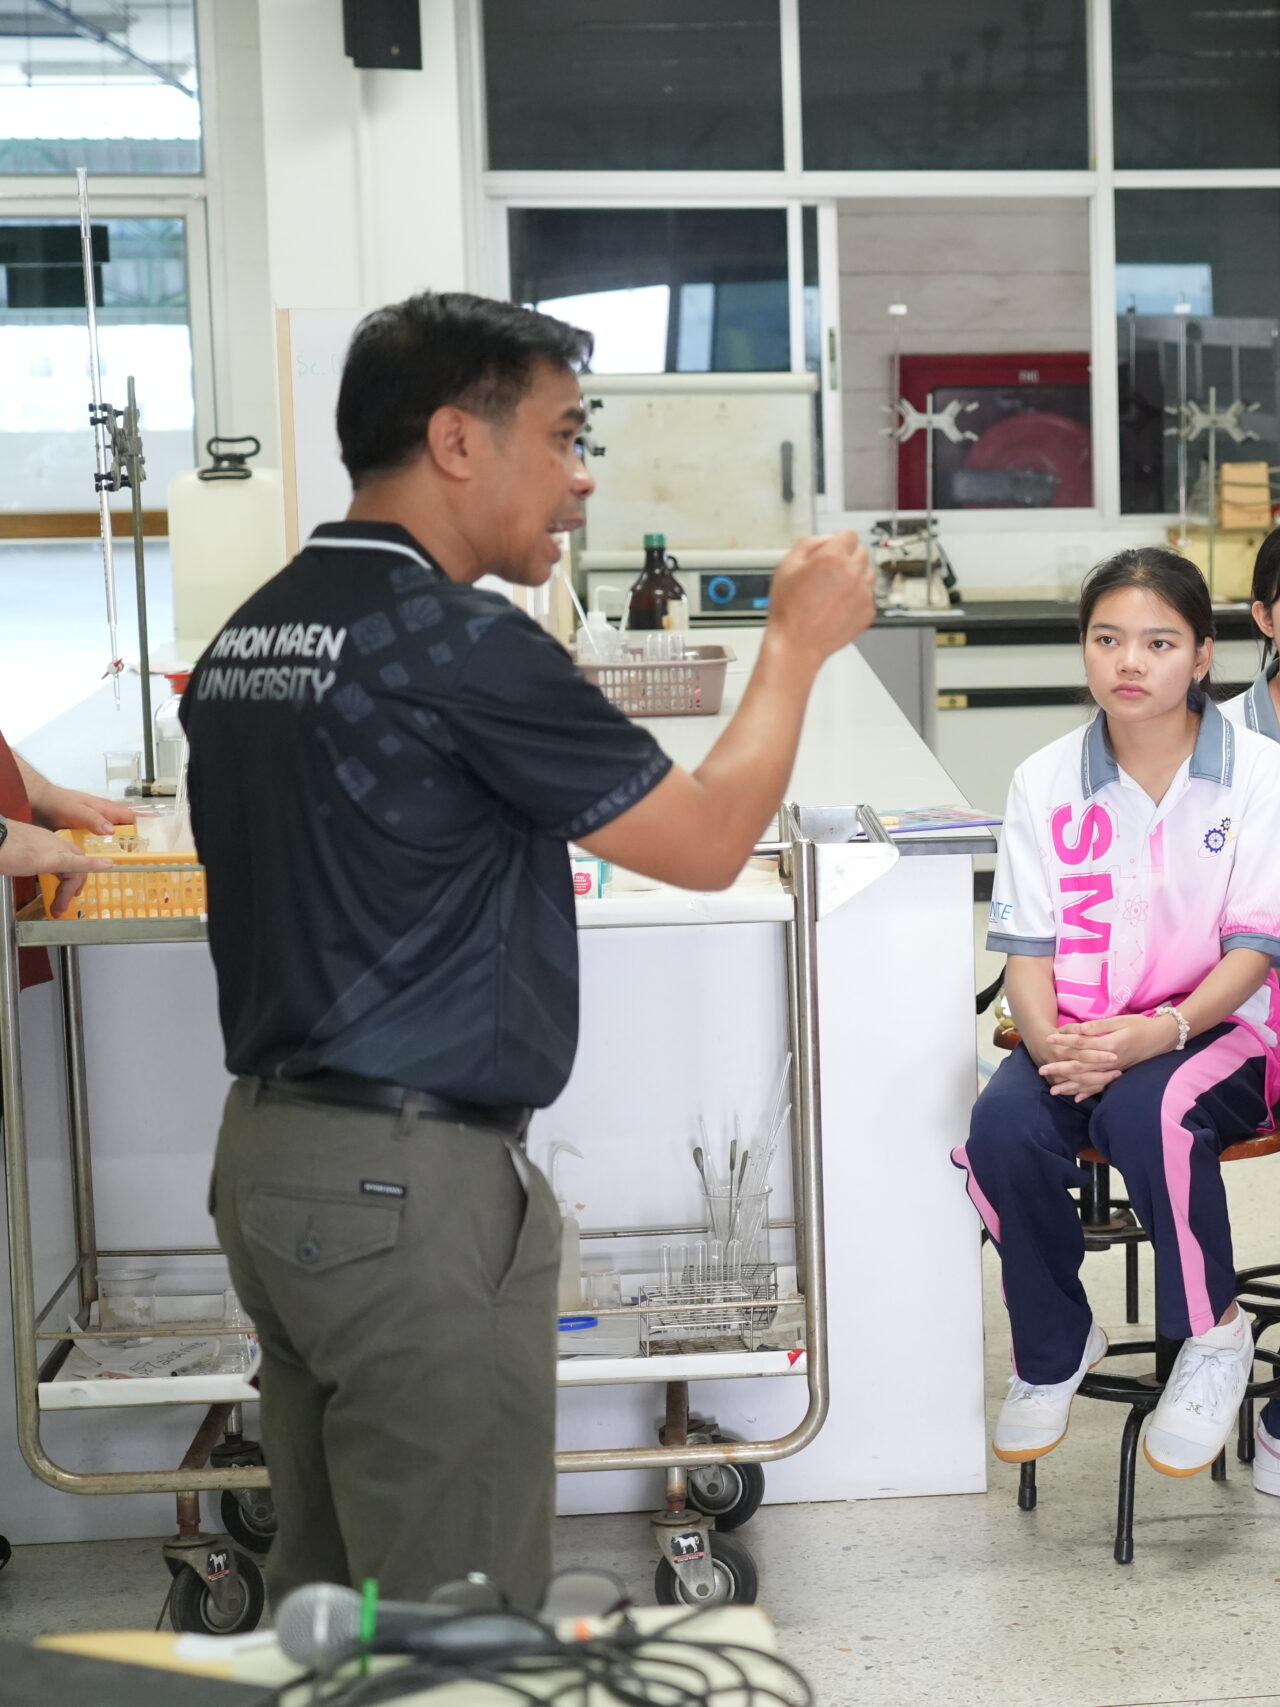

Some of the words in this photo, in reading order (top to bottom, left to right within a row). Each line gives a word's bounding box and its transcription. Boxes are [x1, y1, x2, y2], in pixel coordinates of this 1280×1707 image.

[210, 625, 277, 659] KHON
[273, 621, 347, 661] KAEN
[197, 664, 336, 704] UNIVERSITY
